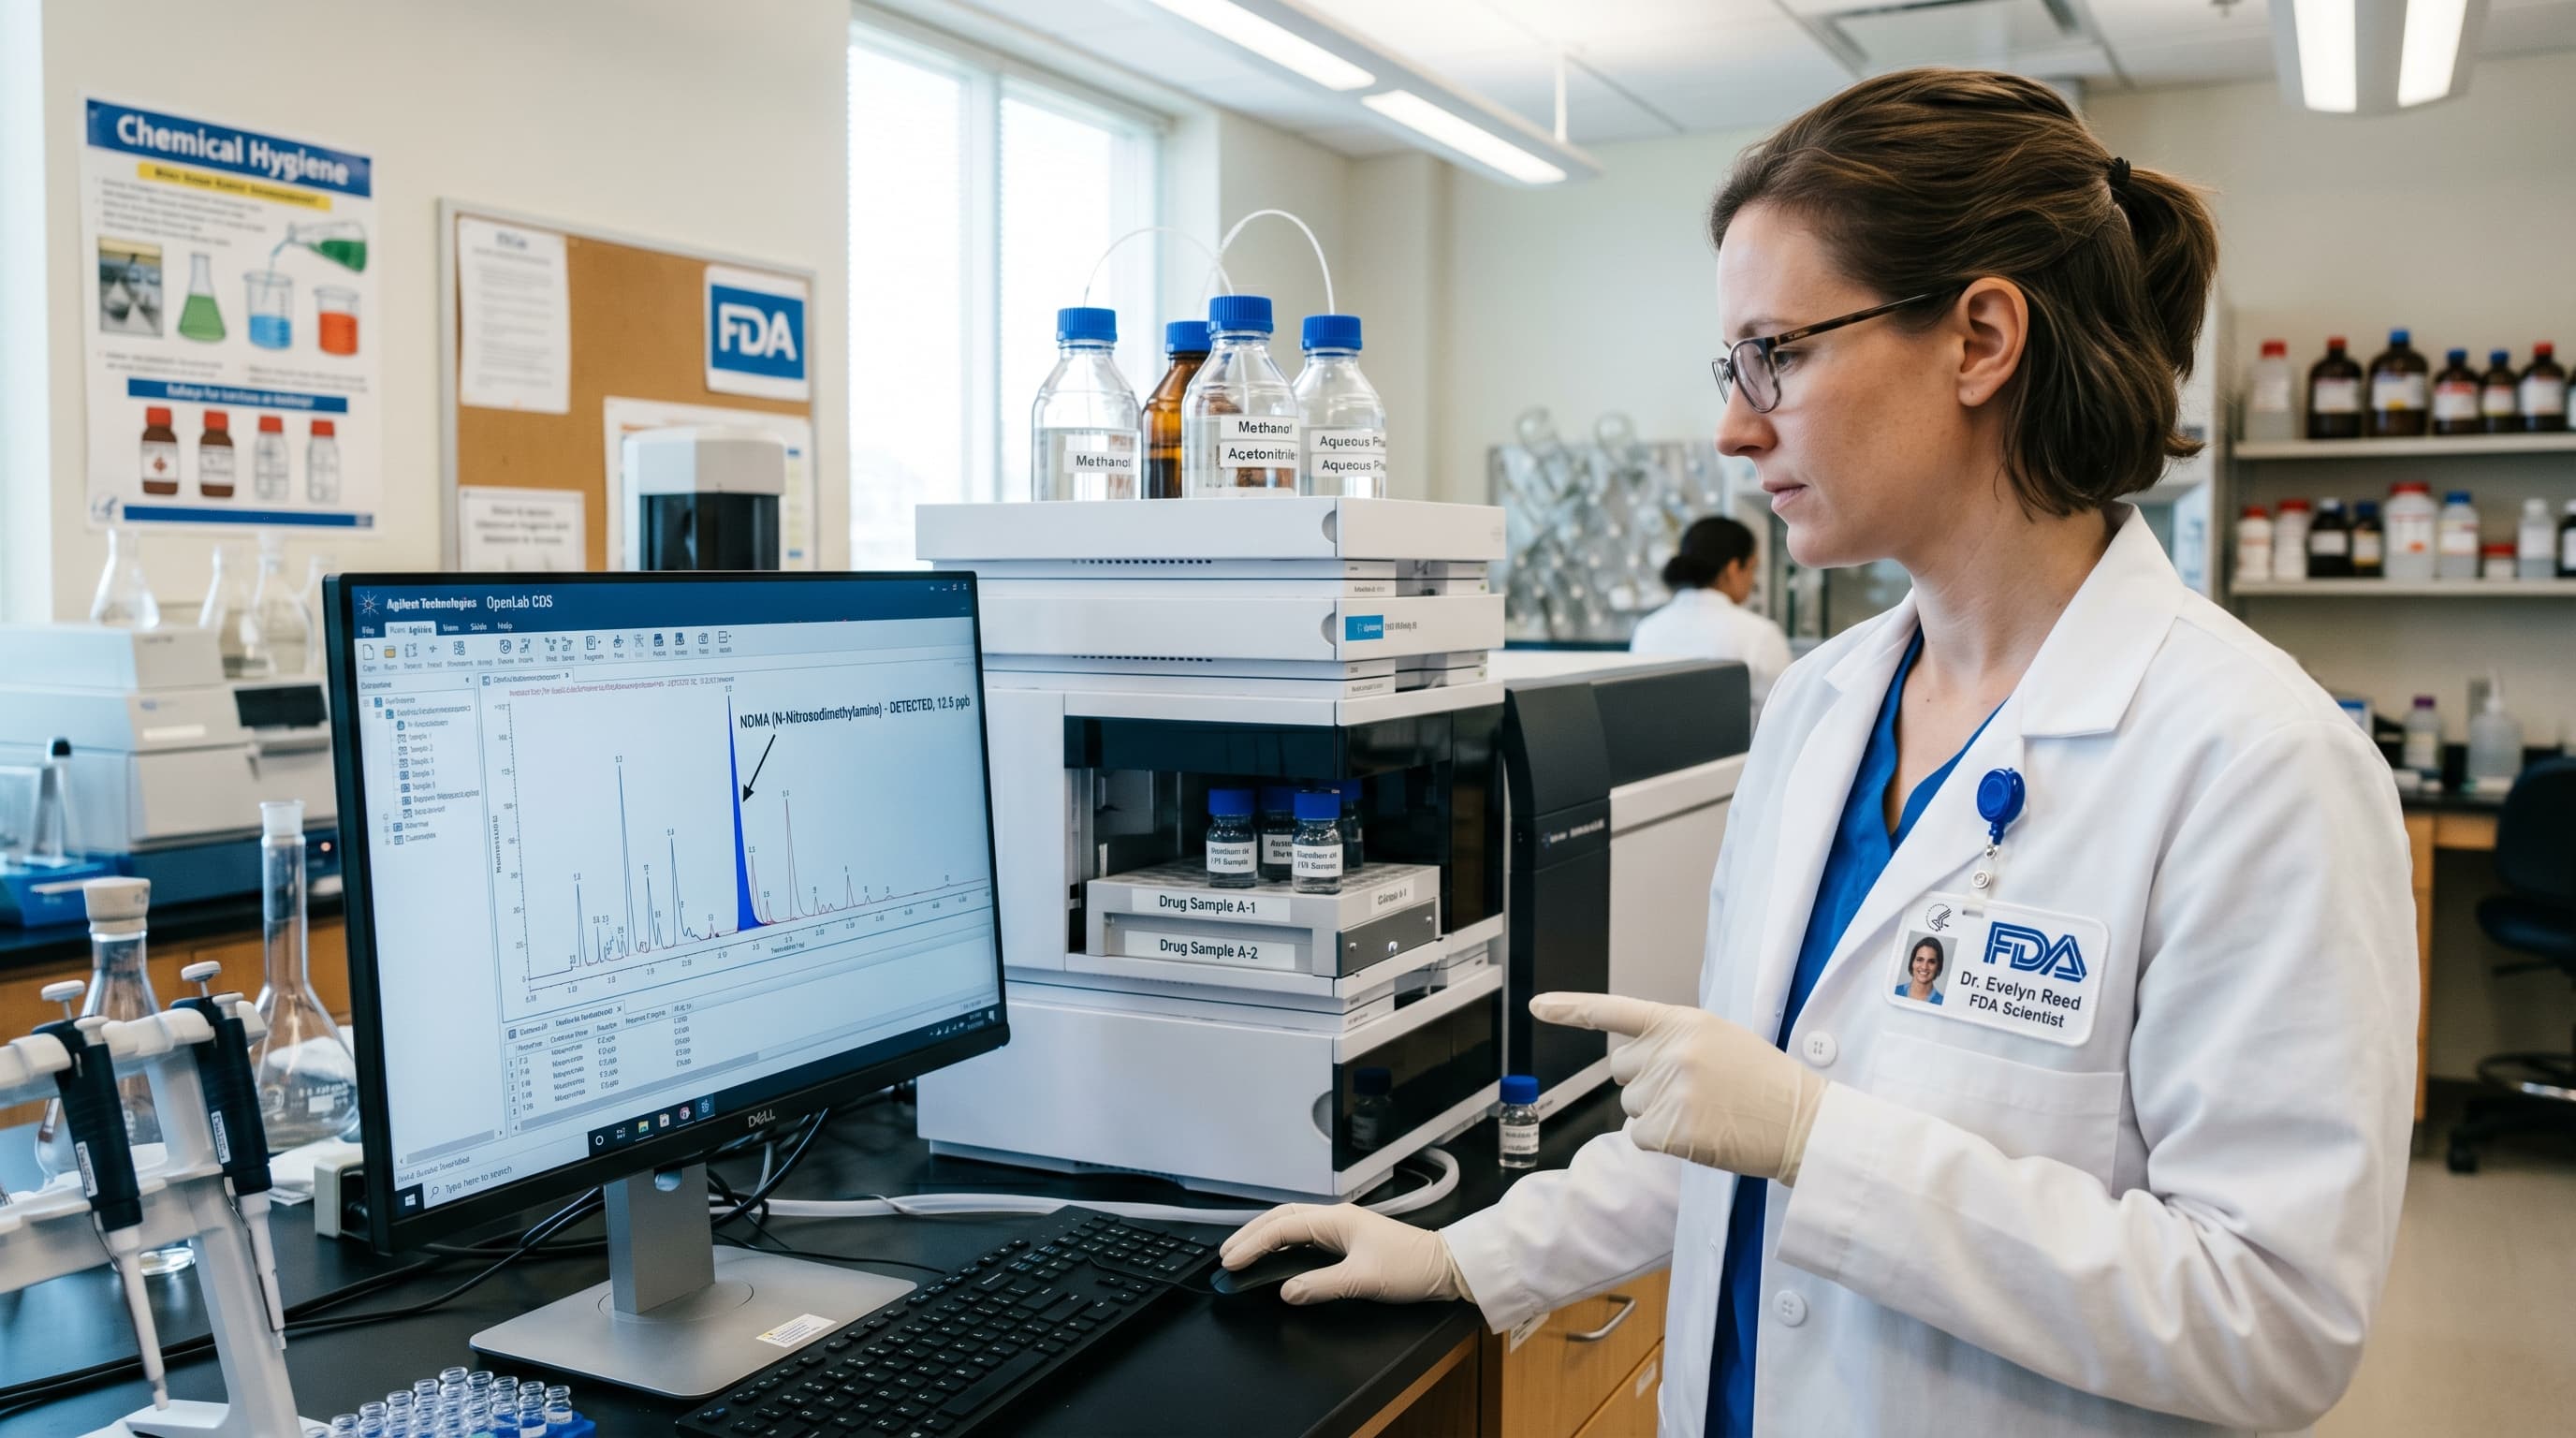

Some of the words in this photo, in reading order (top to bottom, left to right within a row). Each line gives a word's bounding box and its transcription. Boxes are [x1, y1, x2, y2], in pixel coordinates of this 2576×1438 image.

[116, 114, 244, 166] Chemical
[250, 139, 350, 185] Hygiene
[718, 301, 797, 361] FDA
[1237, 421, 1293, 434] Methanol
[1320, 436, 1370, 449] Aqueous
[1076, 455, 1131, 468] Methanol
[1322, 460, 1371, 474] Aqueous
[487, 595, 529, 611] OpenLab
[532, 594, 553, 608] CDS
[739, 713, 770, 729] NDMA
[889, 697, 936, 714] DETECTED,
[937, 696, 954, 710] 12.5
[955, 694, 971, 711] ppb
[1159, 895, 1188, 913] Drug
[1190, 896, 1234, 916] Sample
[1237, 900, 1256, 915] A-1
[1160, 938, 1188, 957] Drug
[1190, 941, 1235, 960] Sample
[1236, 946, 1258, 960] A-2
[1983, 921, 2087, 983] FDA
[1960, 971, 1980, 989] Dr.
[1985, 976, 2036, 1002] Evelyn
[2041, 988, 2082, 1011] Reed
[1969, 994, 1998, 1012] FDA
[2002, 1001, 2065, 1028] Scientist
[748, 1108, 776, 1128] DELL
[481, 1172, 490, 1182] to
